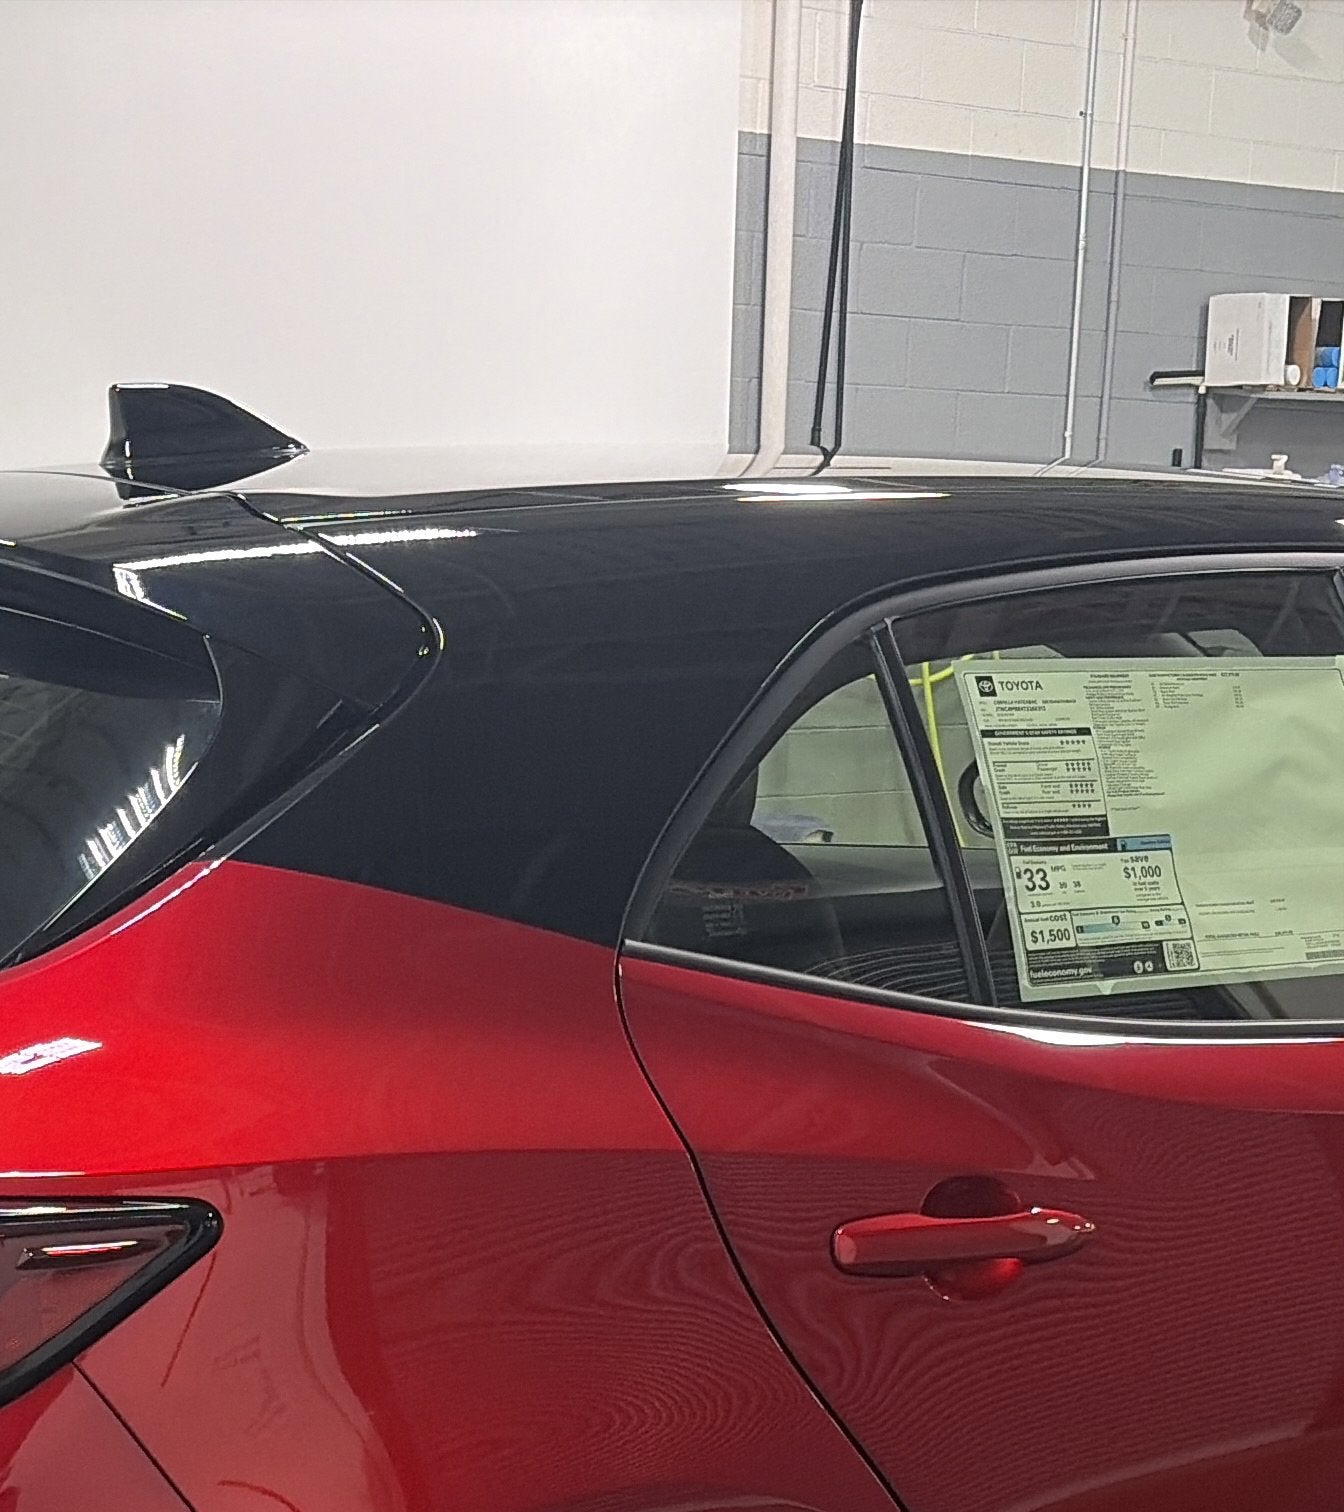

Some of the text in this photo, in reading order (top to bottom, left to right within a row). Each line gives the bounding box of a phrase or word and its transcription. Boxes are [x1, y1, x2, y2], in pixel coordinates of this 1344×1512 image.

[997, 680, 1044, 692] TOYOTA
[1020, 844, 1032, 852] Fuel
[1032, 843, 1059, 853] Economy
[1059, 843, 1070, 851] and
[1071, 842, 1108, 851] Environment
[1129, 855, 1149, 864] save
[1050, 864, 1067, 873] MPG
[1123, 864, 1162, 880] $1,000
[1022, 867, 1051, 892] 33
[1049, 912, 1068, 922] cost
[1030, 927, 1071, 945] $1,500
